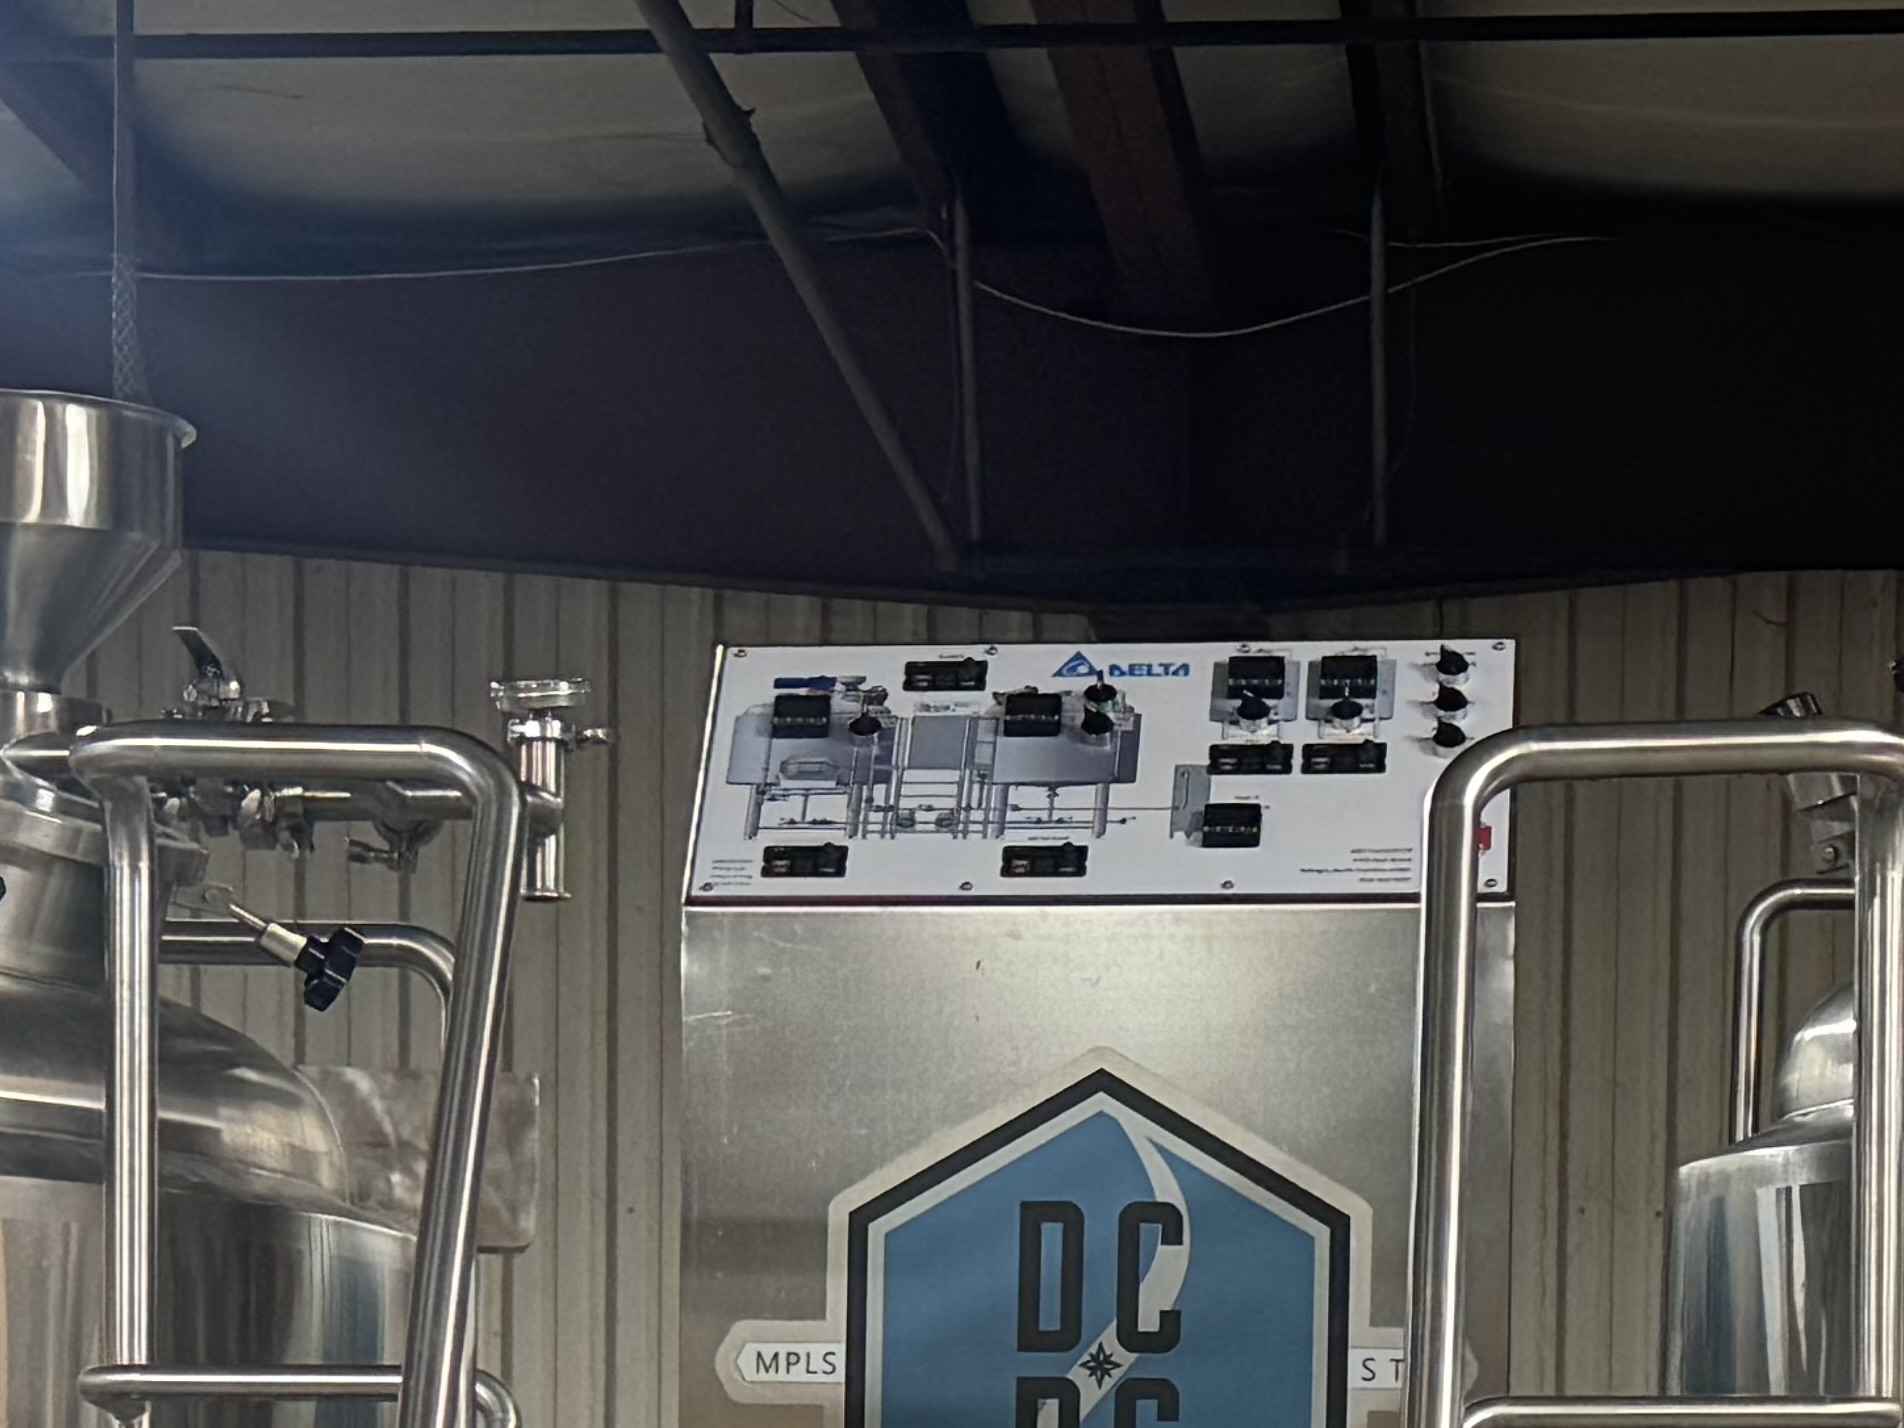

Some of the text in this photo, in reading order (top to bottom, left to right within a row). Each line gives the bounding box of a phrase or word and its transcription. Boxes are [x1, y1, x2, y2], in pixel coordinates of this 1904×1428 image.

[1108, 662, 1191, 678] DELTA
[1015, 1199, 1185, 1355] DC
[754, 1349, 838, 1377] MPLS
